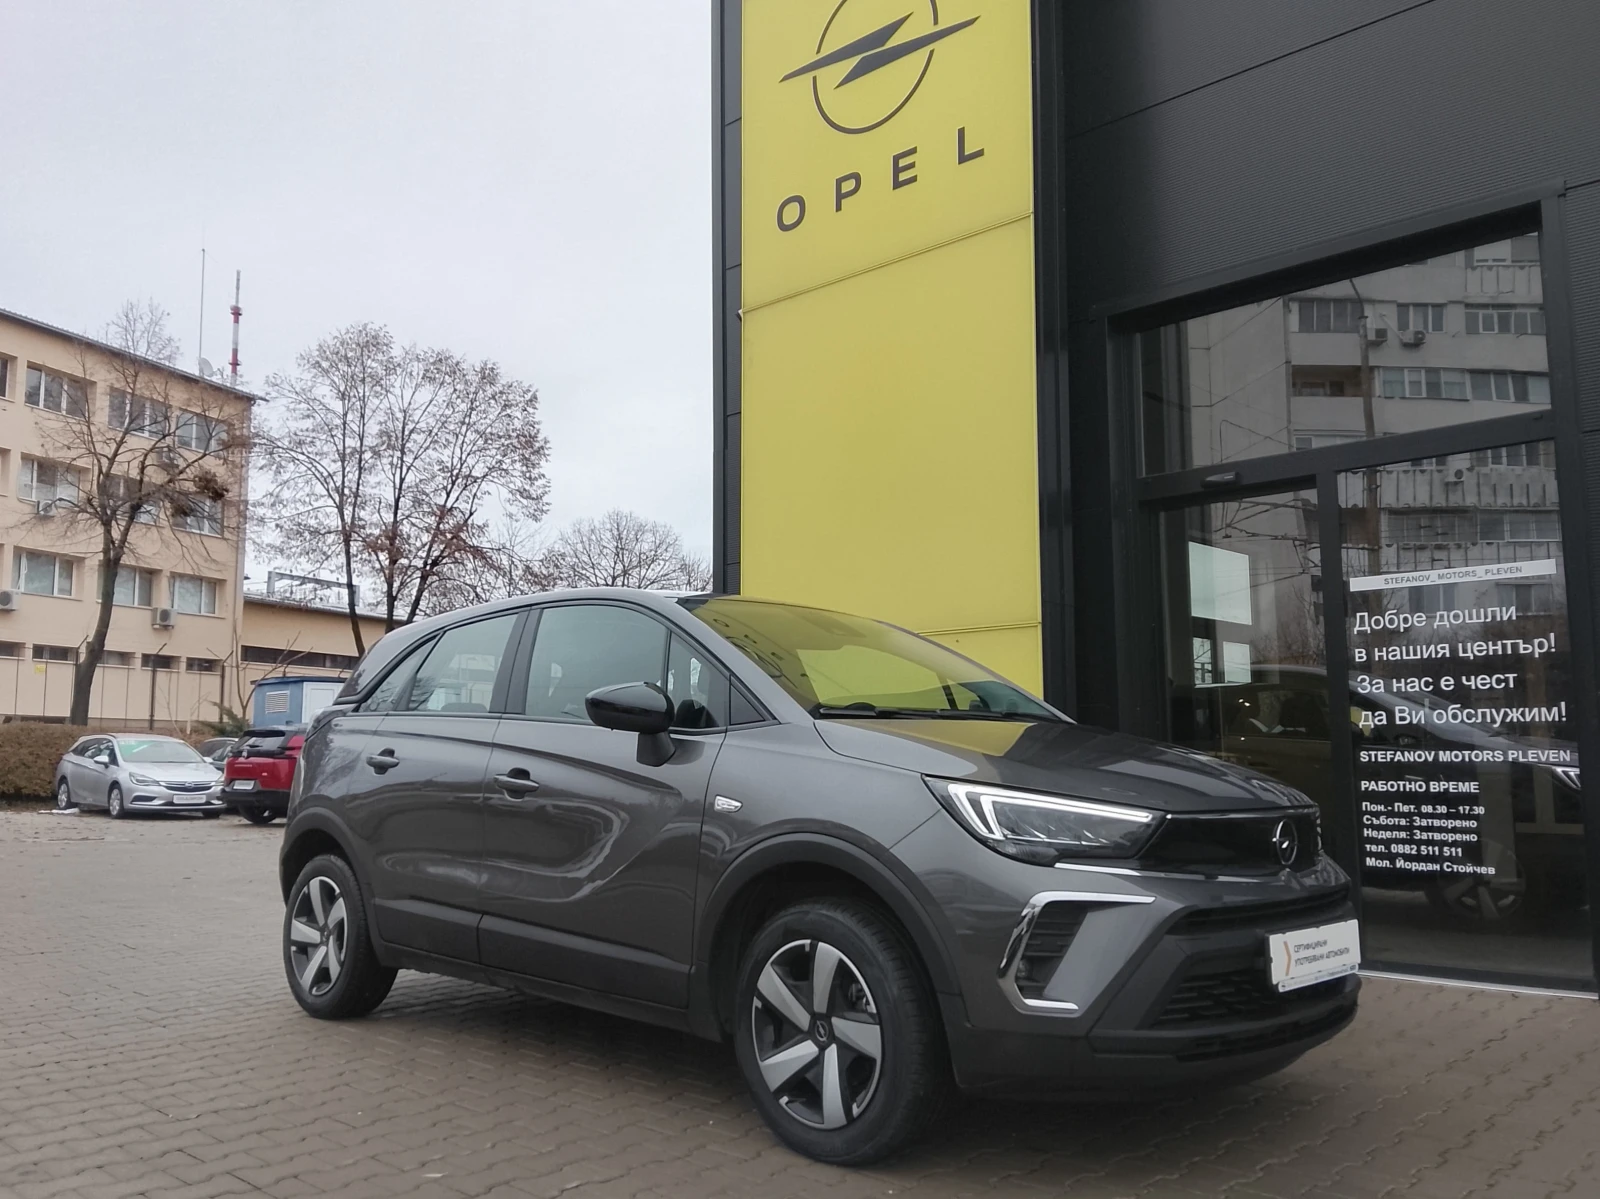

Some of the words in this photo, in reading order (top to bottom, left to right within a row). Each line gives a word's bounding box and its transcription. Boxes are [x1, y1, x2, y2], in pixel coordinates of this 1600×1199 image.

[776, 126, 985, 232] OPEL
[1485, 566, 1523, 576] PLEVEN
[1353, 609, 1427, 634] Добре
[1433, 606, 1517, 629] дошли
[1355, 648, 1367, 662] в
[1374, 642, 1450, 661] нашия
[1458, 632, 1556, 659] център!
[1357, 675, 1385, 694] За
[1392, 676, 1434, 692] нас
[1440, 675, 1455, 691] е
[1461, 673, 1518, 690] чест
[1359, 709, 1387, 729] да
[1395, 706, 1425, 725] Ви
[1433, 701, 1567, 727] обслужим!
[1359, 751, 1437, 763] STEFANOV
[1438, 750, 1504, 762] MOTORS
[1508, 750, 1571, 762] PLEVEN
[1360, 781, 1426, 793] РАБОТНО
[1429, 782, 1480, 793] ВРЕМЕ
[1394, 802, 1418, 813] Пет.
[1421, 804, 1447, 814] 08.30
[1458, 805, 1485, 815] 17.30
[1362, 815, 1410, 826] Събота:
[1412, 816, 1478, 829] Затворено
[1363, 828, 1411, 840] Неделя:
[1412, 830, 1478, 842] Затворено
[1365, 844, 1388, 853] тел.
[1390, 844, 1418, 855] 0882
[1420, 845, 1440, 856] 511
[1443, 846, 1462, 857] 511
[1395, 857, 1440, 872] Йордан
[1443, 862, 1496, 875] Стойчев
